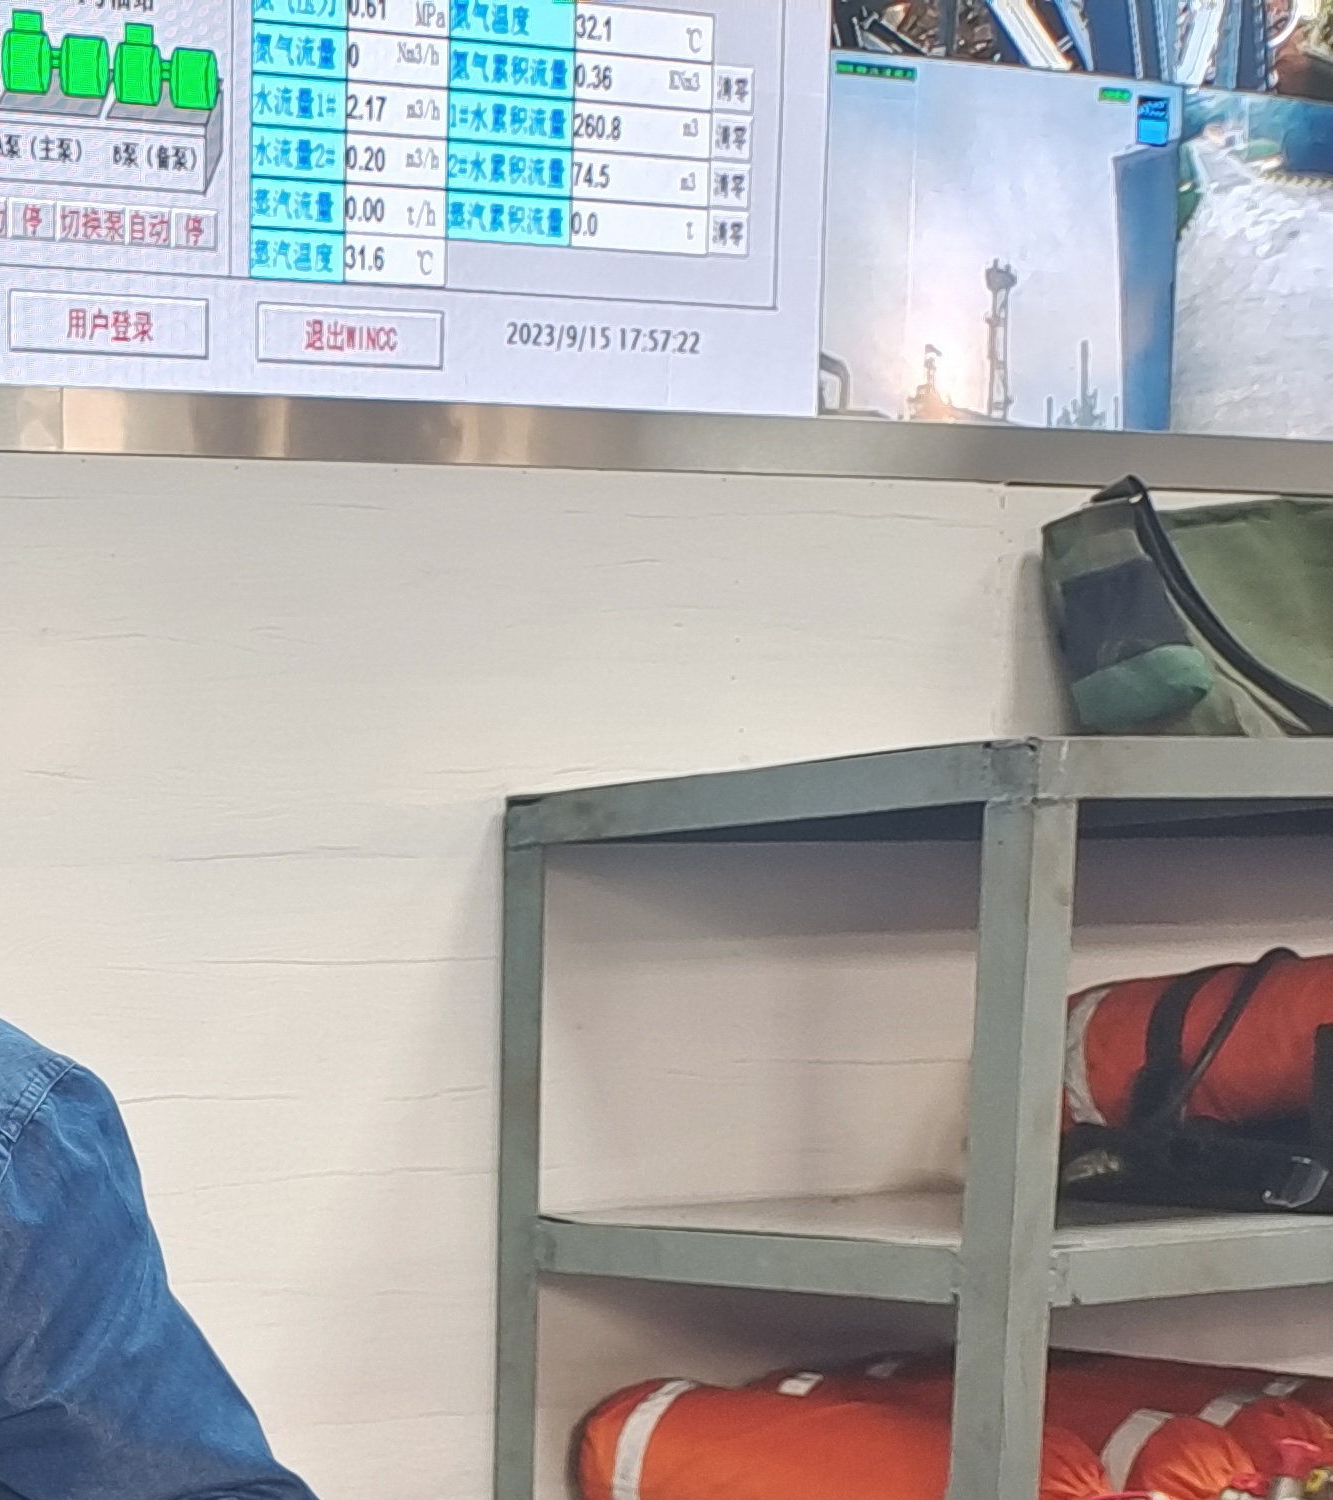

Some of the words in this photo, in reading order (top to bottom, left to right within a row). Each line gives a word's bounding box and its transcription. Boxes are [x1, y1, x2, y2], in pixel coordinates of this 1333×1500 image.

[348, 43, 360, 68] 0
[347, 94, 387, 122] 2.17
[574, 117, 621, 140] 260.8
[347, 145, 386, 172] 0.20
[573, 162, 610, 189] 74.5
[346, 196, 385, 223] 0.00
[572, 212, 598, 237] 0.0
[346, 244, 385, 271] 31.6
[66, 308, 155, 343] 用户登录
[505, 320, 612, 353] 2023/9/15
[619, 326, 702, 355] 17:57:22
